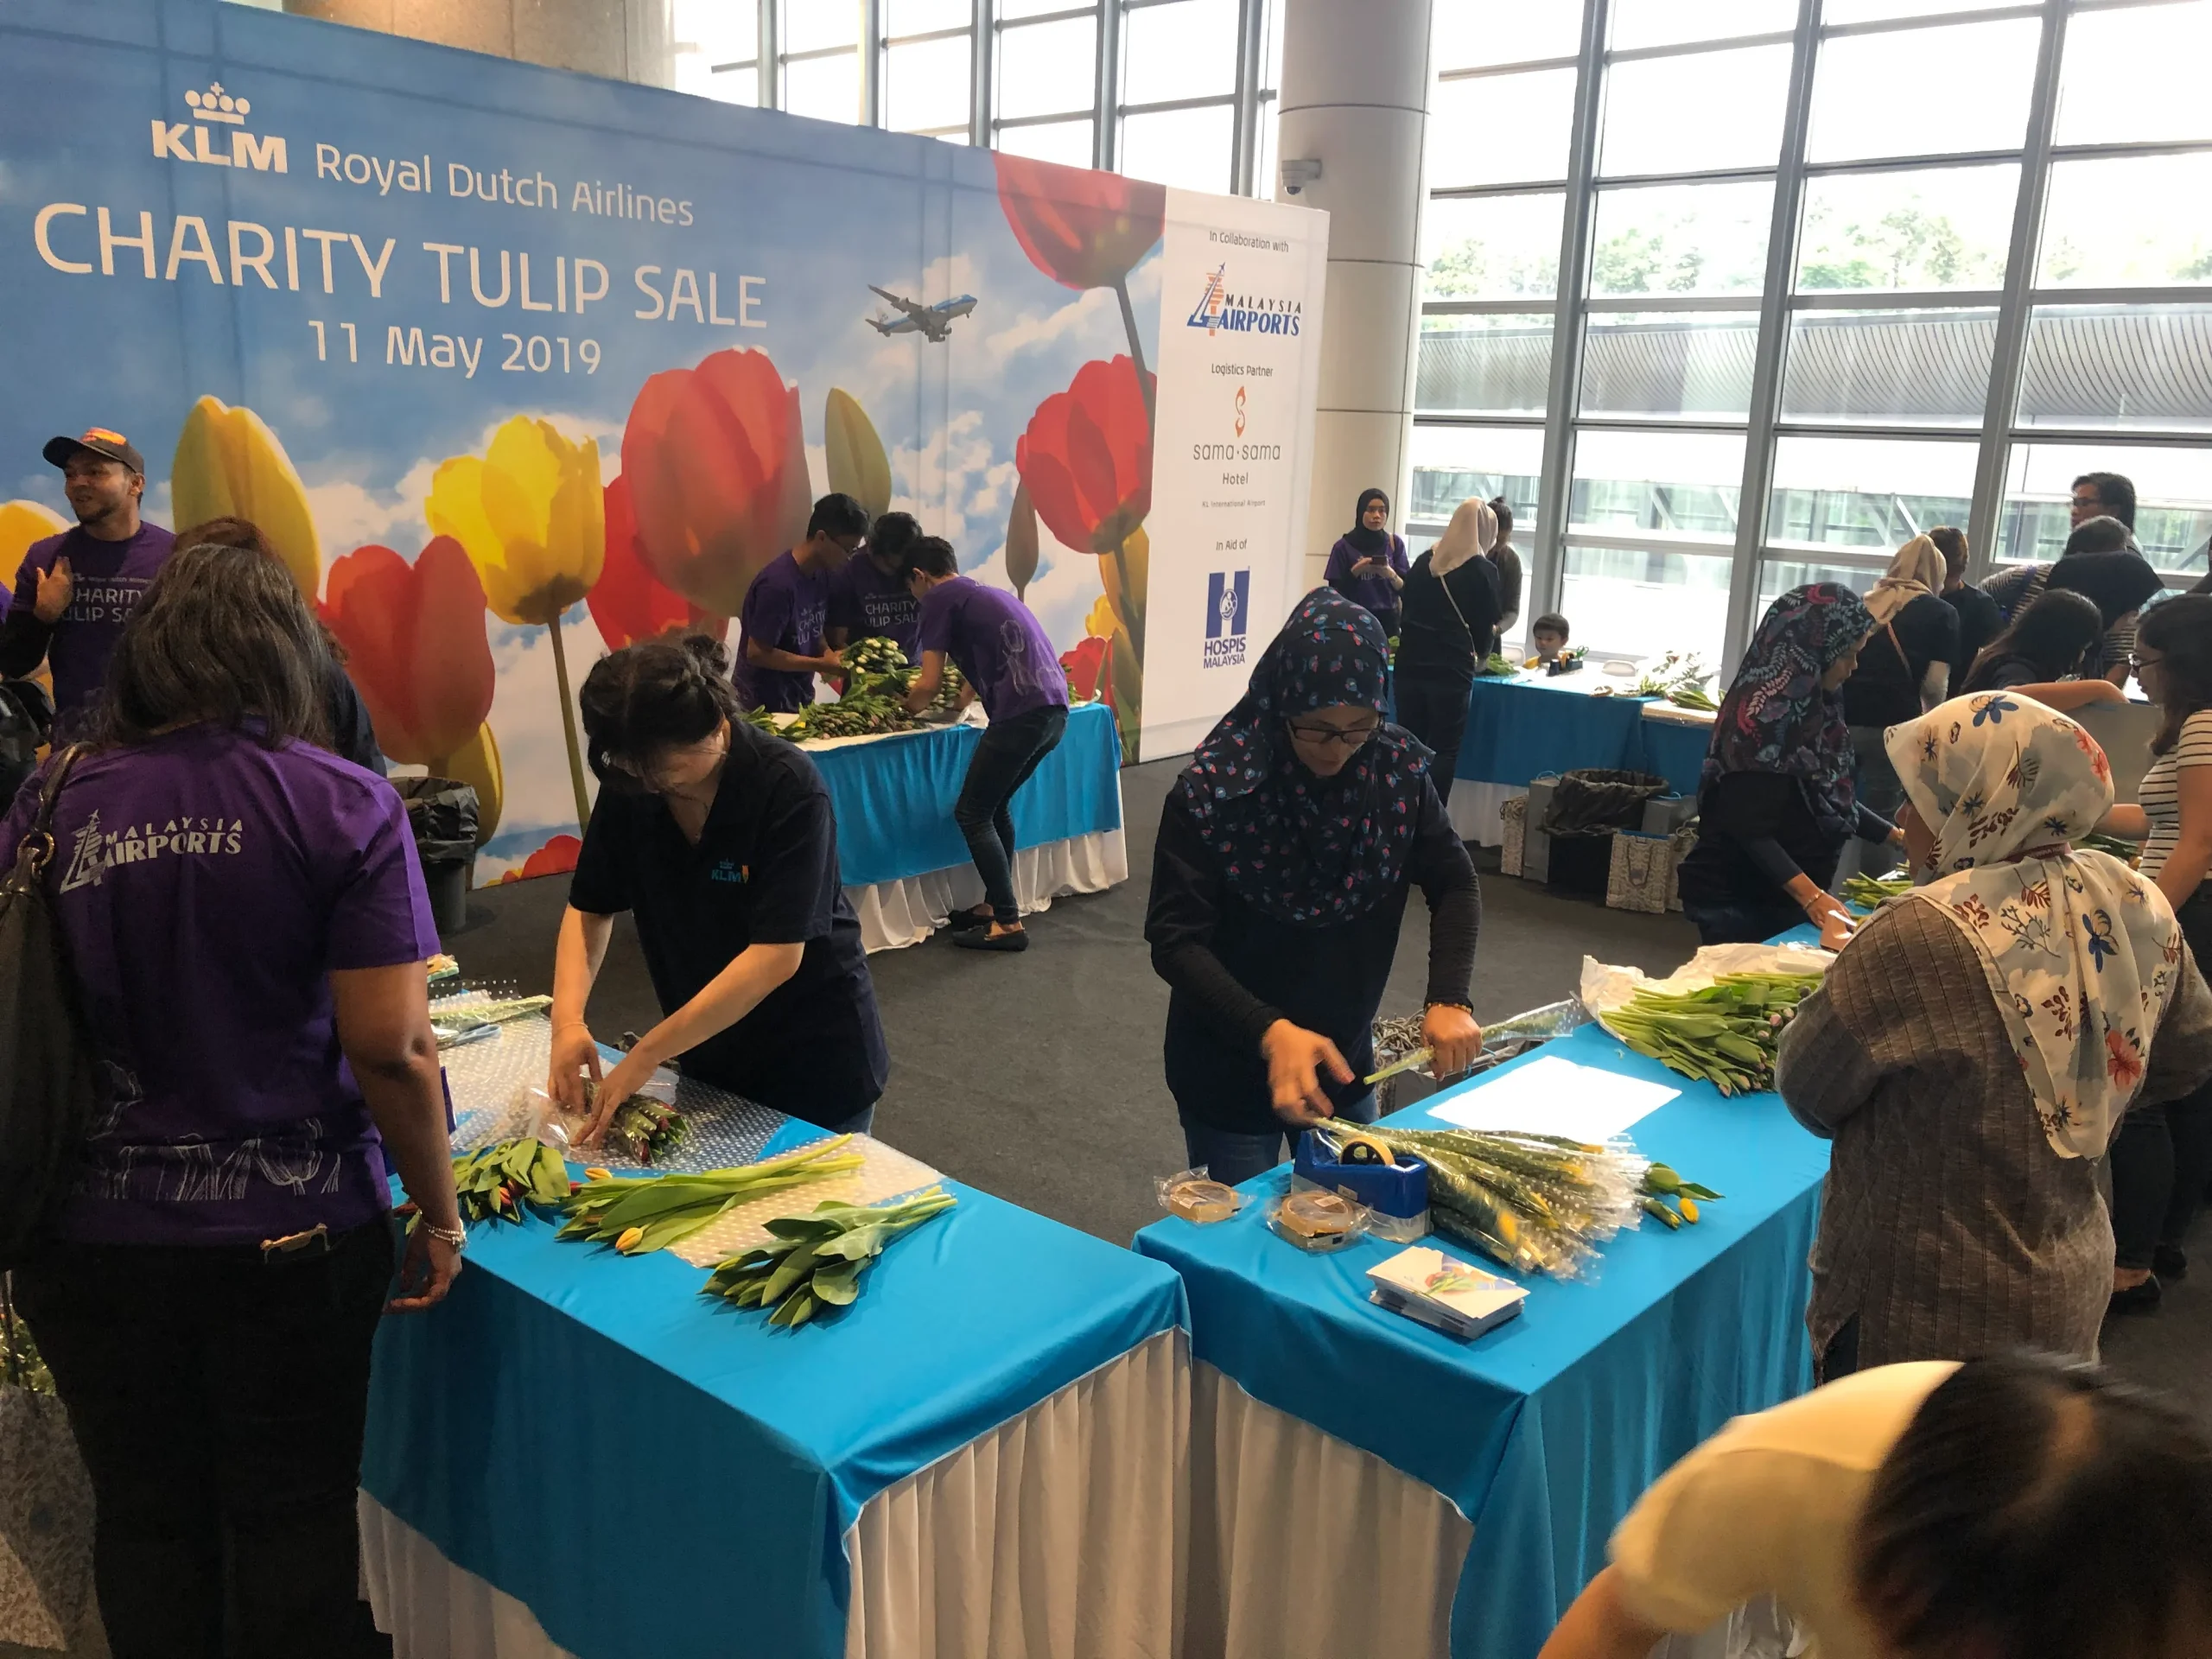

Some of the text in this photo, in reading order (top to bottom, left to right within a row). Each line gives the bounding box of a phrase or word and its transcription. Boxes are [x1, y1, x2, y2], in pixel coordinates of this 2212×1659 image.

[151, 119, 694, 226] KLM Royal Dutch Airlines
[1210, 231, 1289, 253] In Collaboration with
[34, 203, 766, 328] CHARITY TULIP SALE
[1224, 293, 1302, 315] MALAYSIA
[1217, 308, 1300, 336] AIRPORTS
[308, 321, 601, 379] 11 May 2019
[1211, 363, 1274, 378] Logistics Partner
[1222, 472, 1249, 486] Hotel
[1216, 538, 1248, 550] In Aid of
[76, 587, 143, 605] HARIT
[63, 606, 105, 622] ULIP
[864, 614, 892, 629] ULIP
[1204, 637, 1246, 657] HOSPIS
[1203, 653, 1245, 670] MALAYSIA
[105, 817, 244, 846] MALAYSIA
[102, 830, 243, 868] AIRPORTS
[711, 868, 741, 883] KLM
